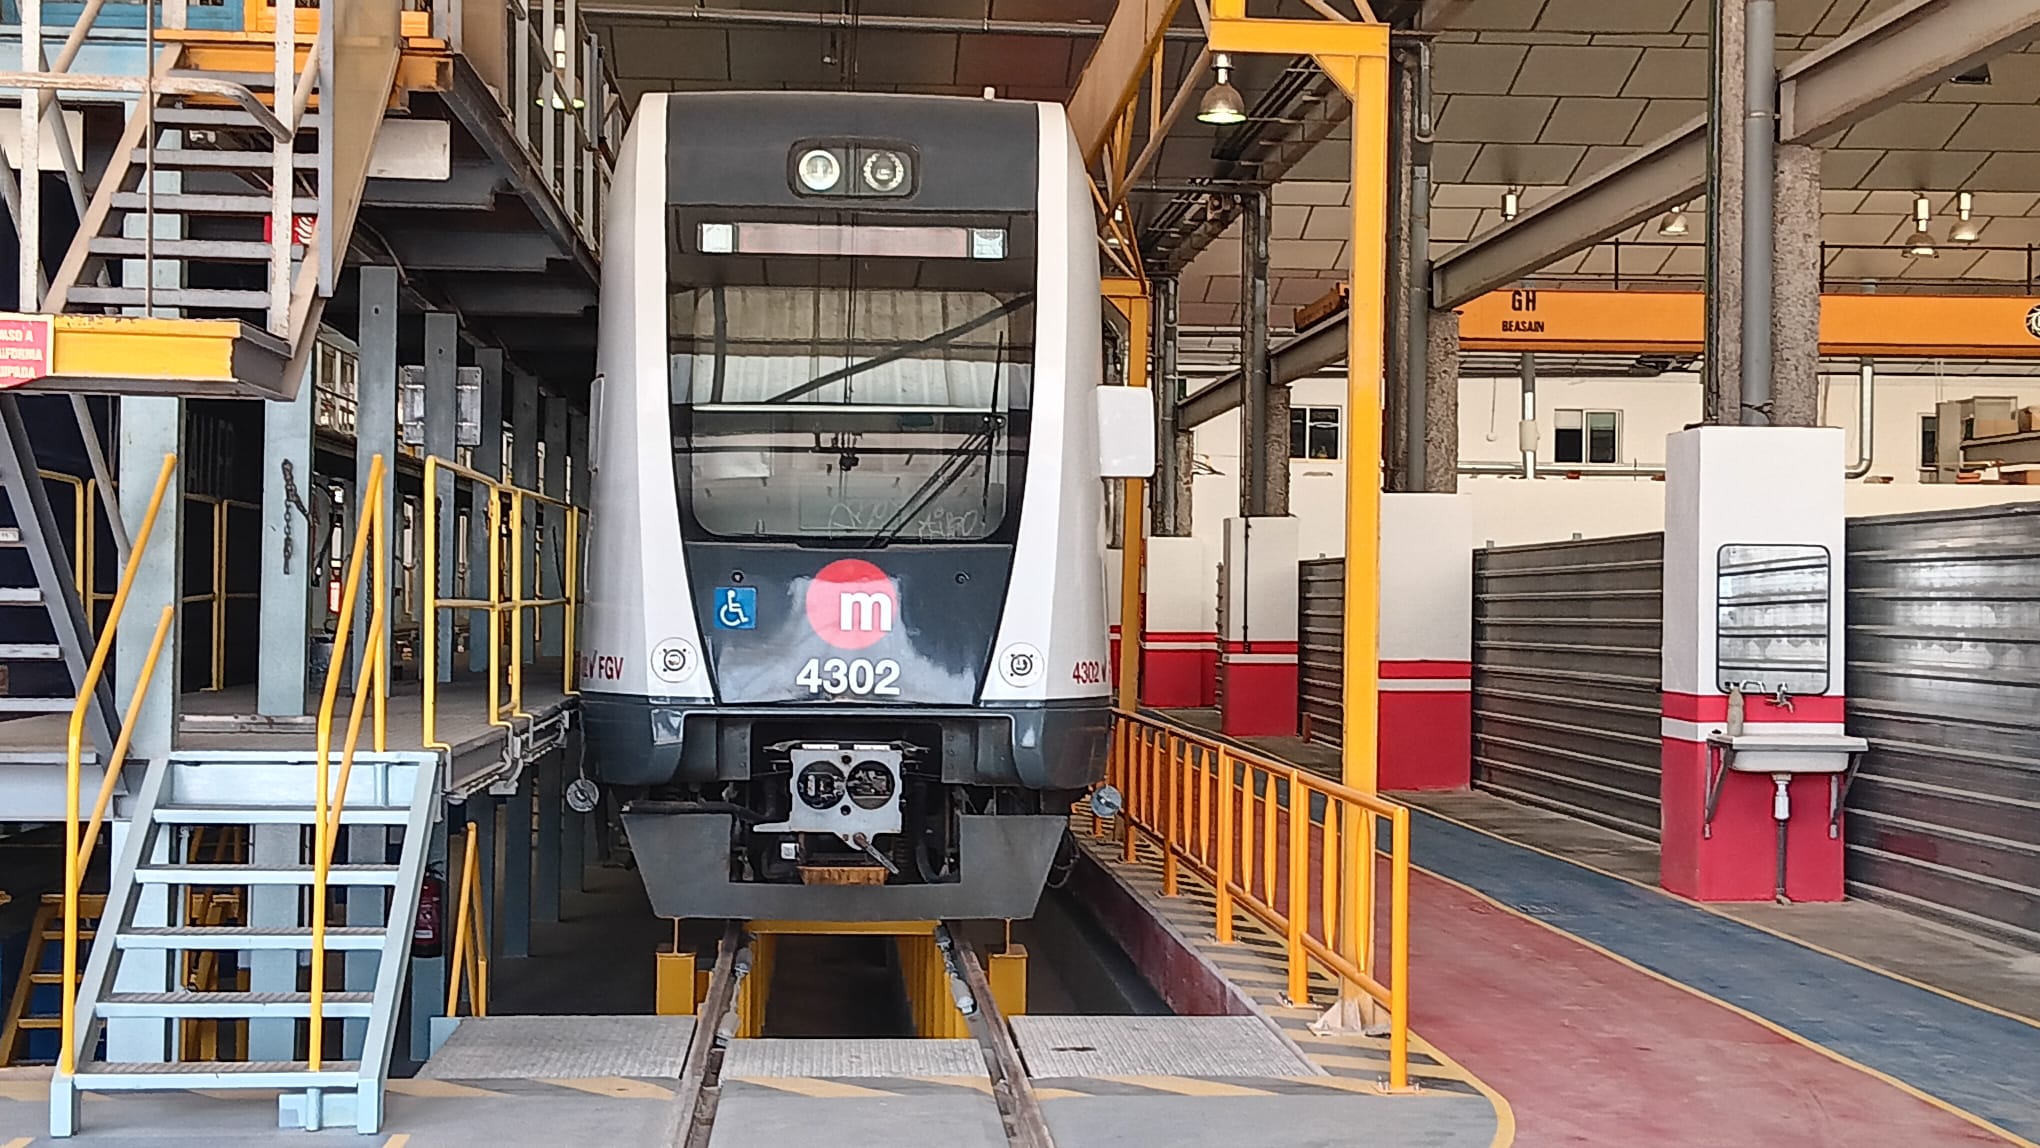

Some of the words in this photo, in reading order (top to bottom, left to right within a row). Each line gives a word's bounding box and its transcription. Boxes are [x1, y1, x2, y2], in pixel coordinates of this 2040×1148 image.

[1512, 290, 1536, 311] GH
[25, 330, 33, 343] A
[1502, 320, 1545, 333] BEASAIN
[840, 592, 892, 632] m
[598, 655, 624, 680] FGV
[796, 658, 901, 695] 4302
[1072, 661, 1100, 685] 4302
